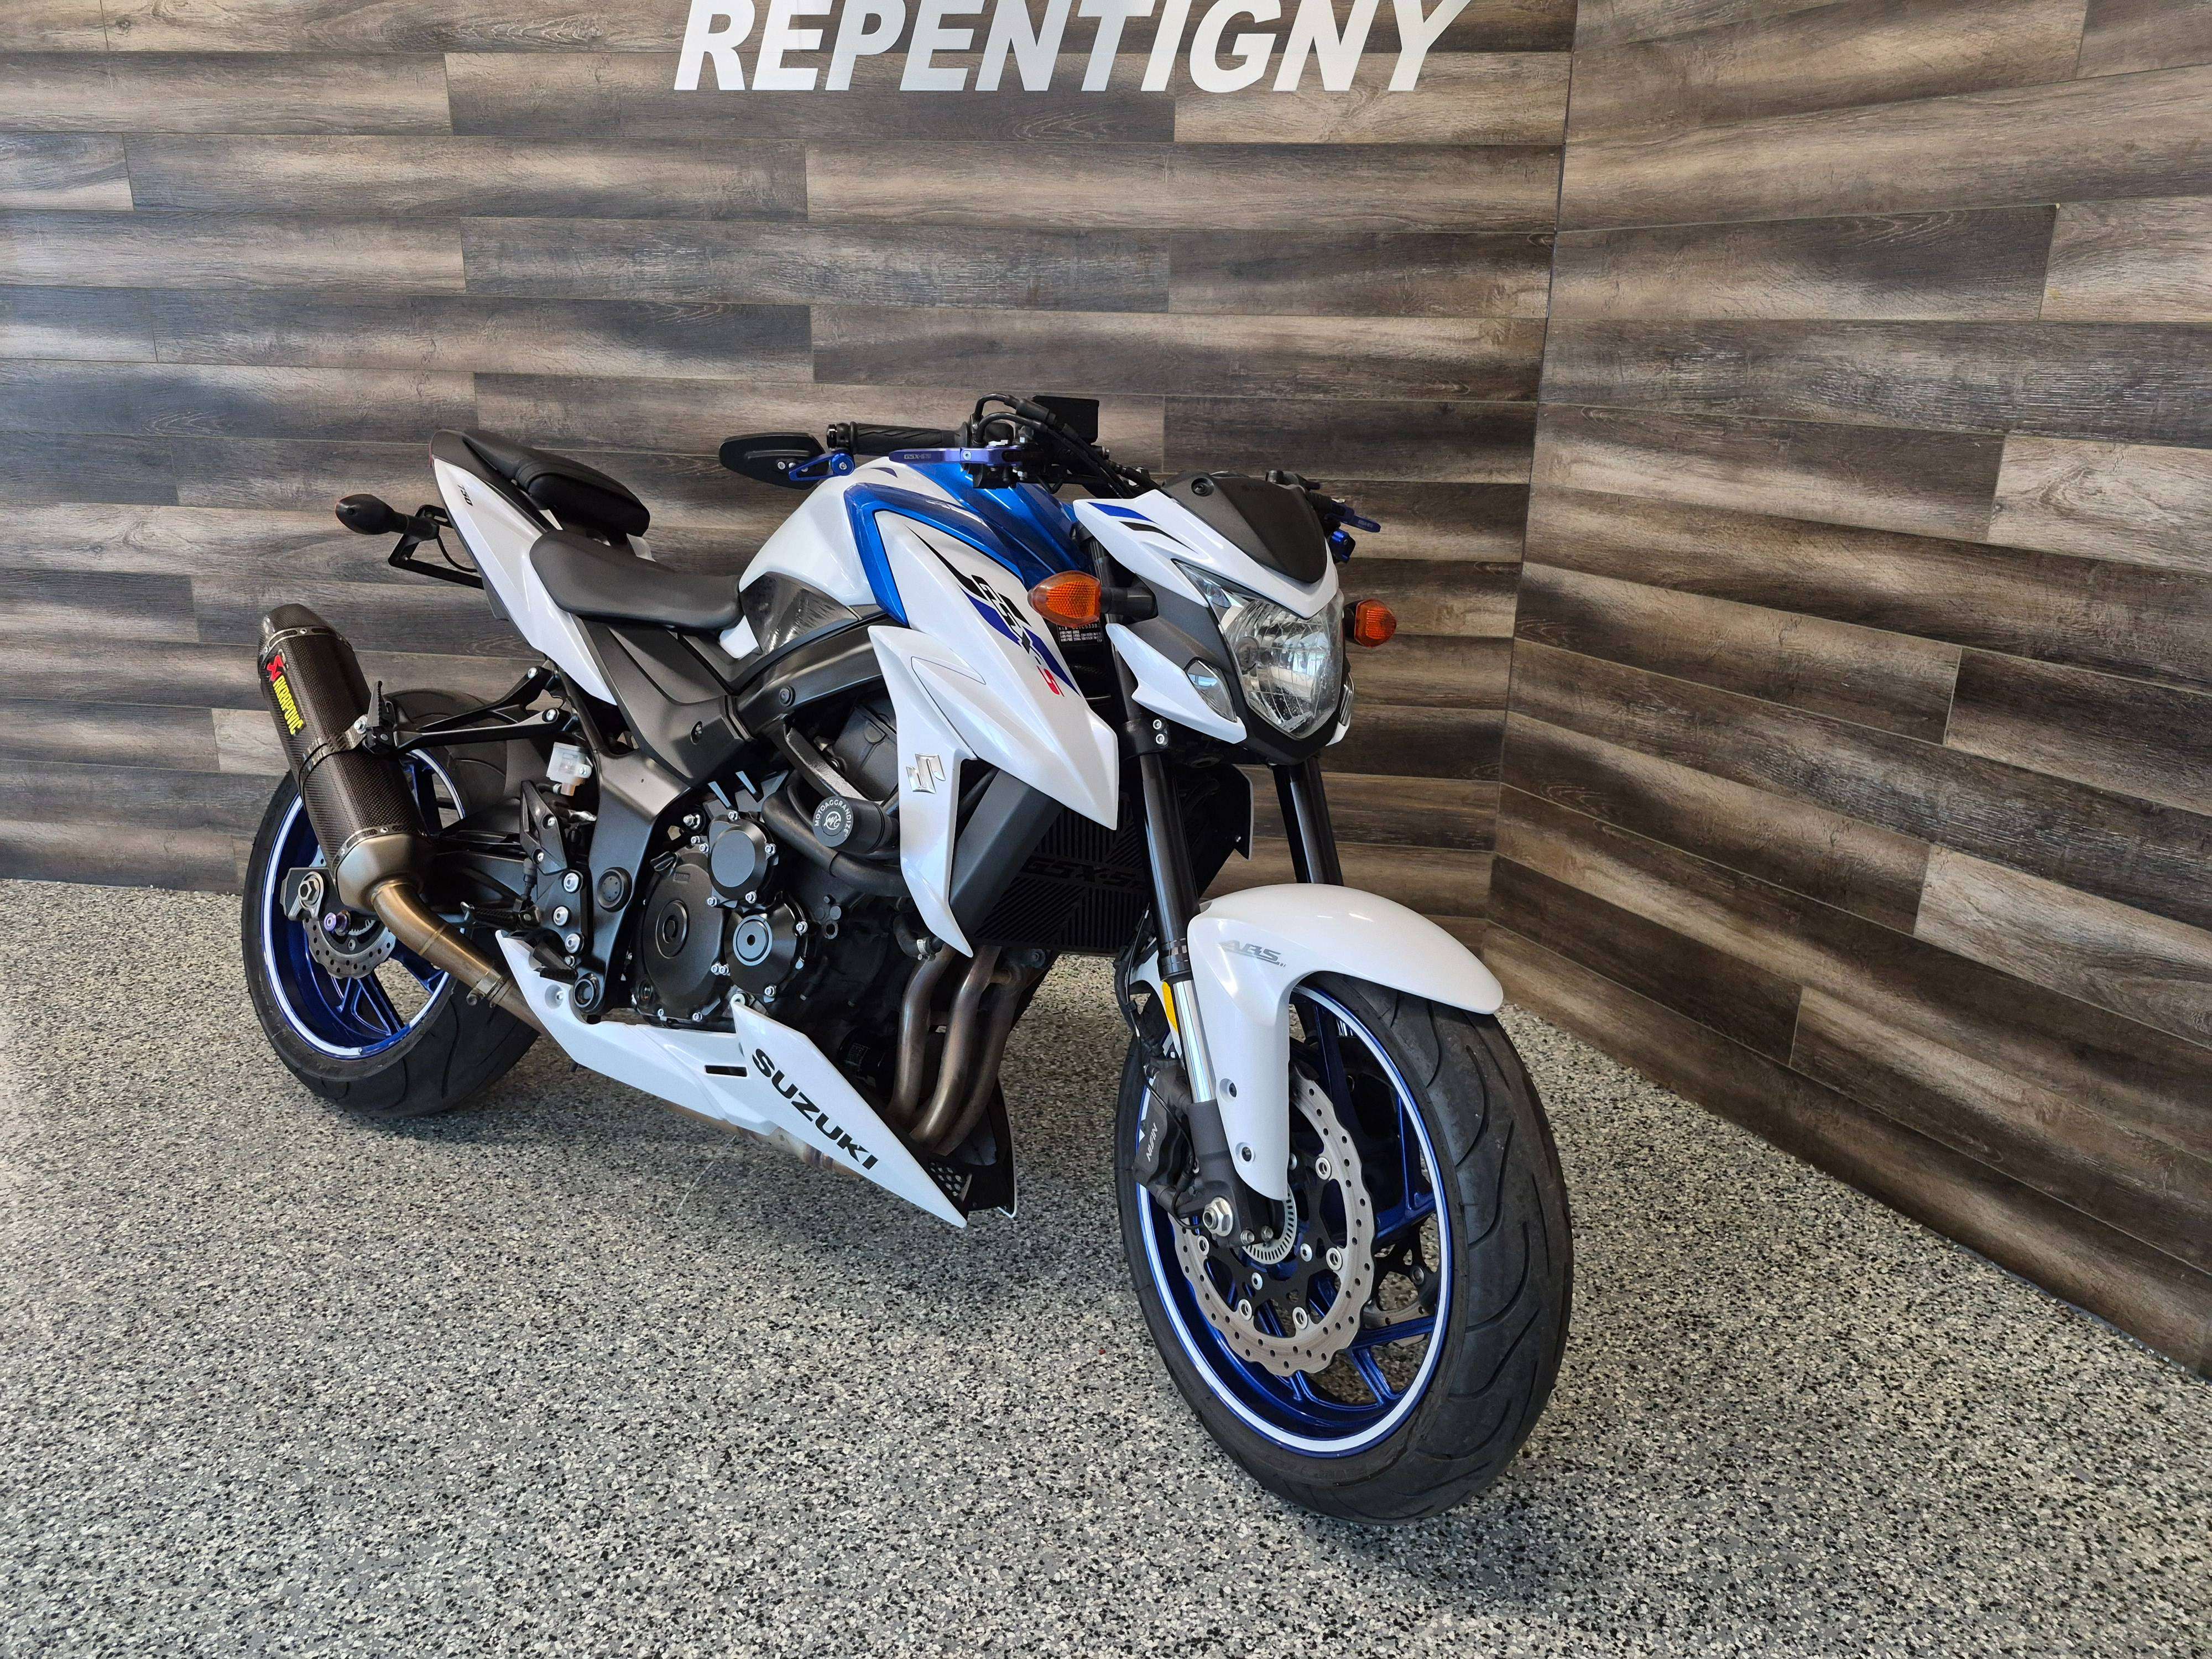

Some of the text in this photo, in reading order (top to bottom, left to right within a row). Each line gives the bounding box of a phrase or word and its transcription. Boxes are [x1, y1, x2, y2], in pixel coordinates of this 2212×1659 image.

[674, 0, 1472, 93] REPENTIGNY
[1218, 940, 1281, 962] ABS
[752, 1048, 879, 1170] SUZUKI
